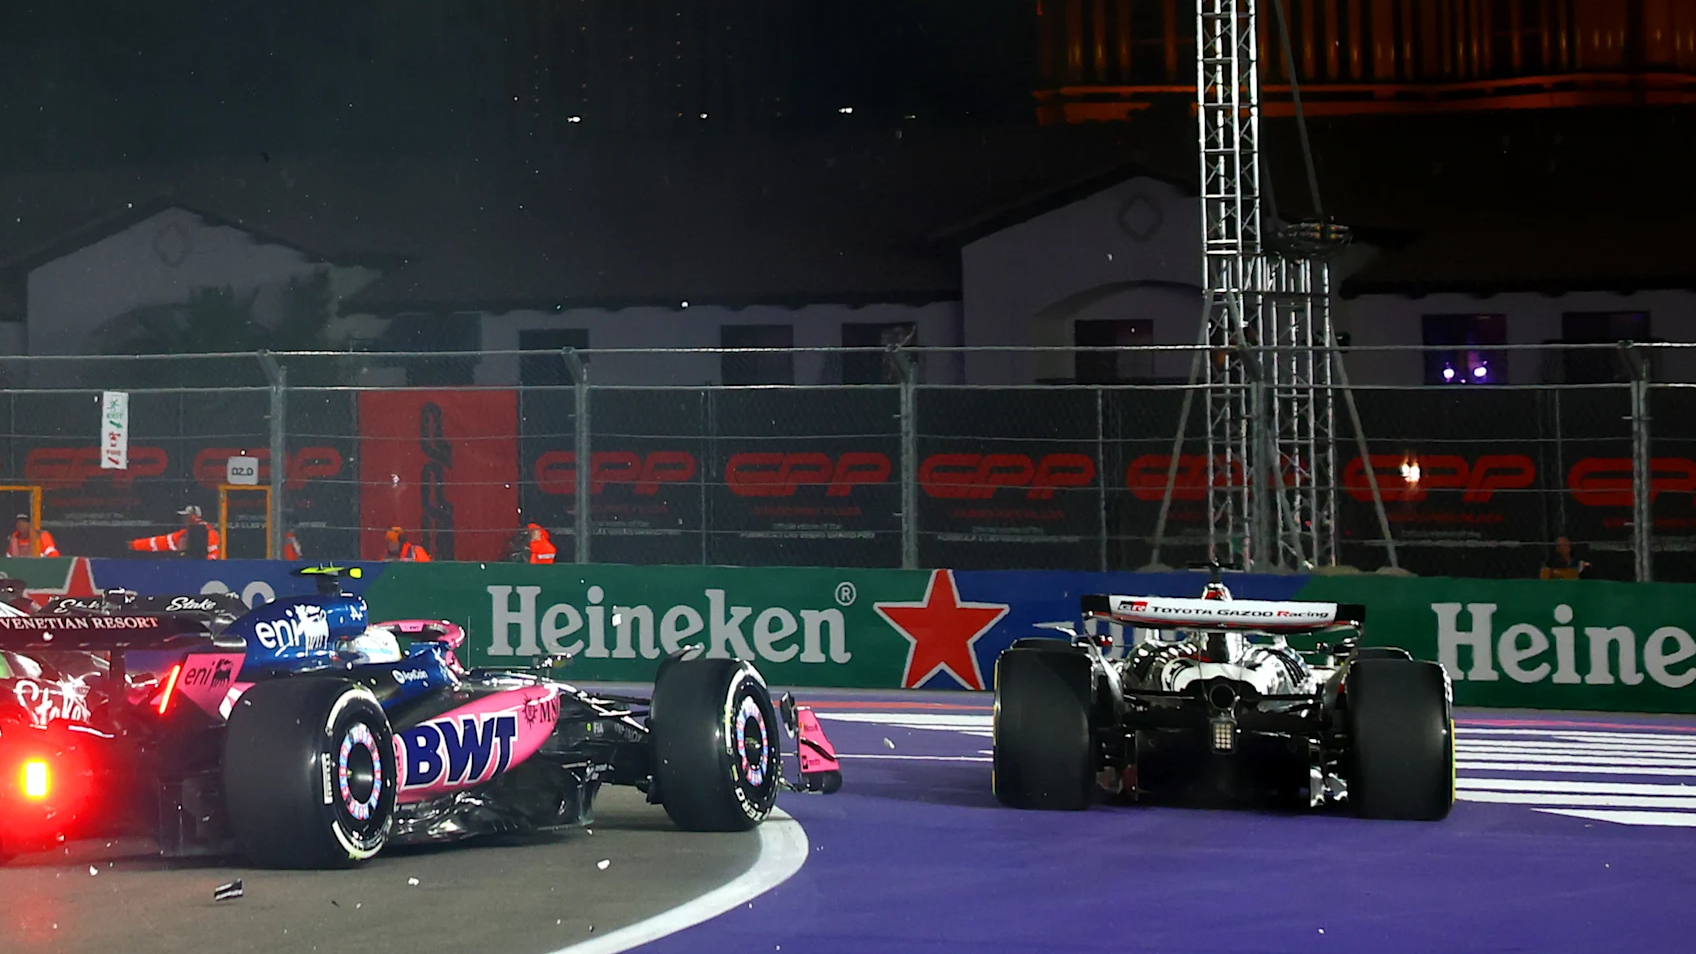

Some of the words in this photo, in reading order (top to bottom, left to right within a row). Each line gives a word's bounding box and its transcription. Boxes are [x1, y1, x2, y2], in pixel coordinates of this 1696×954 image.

[165, 597, 217, 612] Stake
[1151, 606, 1213, 615] TOYOTA
[1217, 609, 1274, 617] GAZOO
[1276, 610, 1330, 620] Racing
[1, 617, 89, 630] VENETIAN
[93, 616, 159, 629] RESORT
[254, 608, 302, 649] eni
[487, 585, 852, 664] Heineken
[185, 663, 217, 686] eni
[399, 713, 518, 790] BWT
